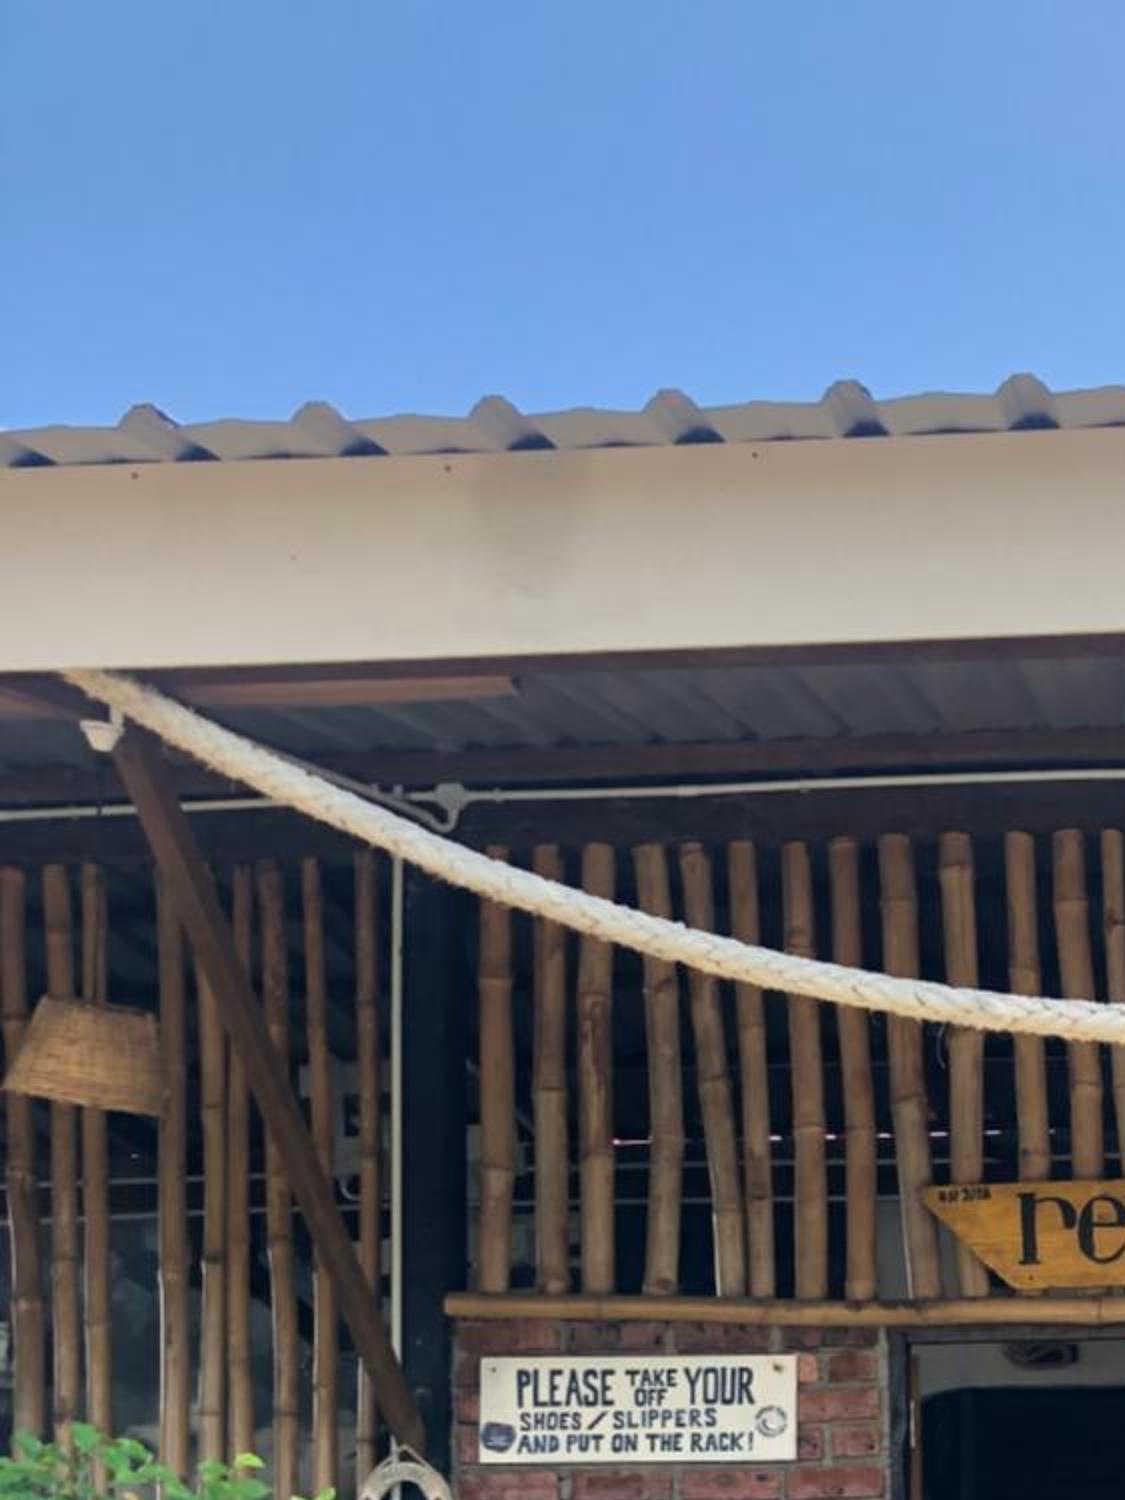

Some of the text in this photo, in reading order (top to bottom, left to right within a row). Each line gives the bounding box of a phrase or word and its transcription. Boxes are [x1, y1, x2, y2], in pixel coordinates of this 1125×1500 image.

[516, 1367, 755, 1408] PLEASE TAKE OFF YOUR
[517, 1431, 754, 1454] AND PUT ON THE RACK!
